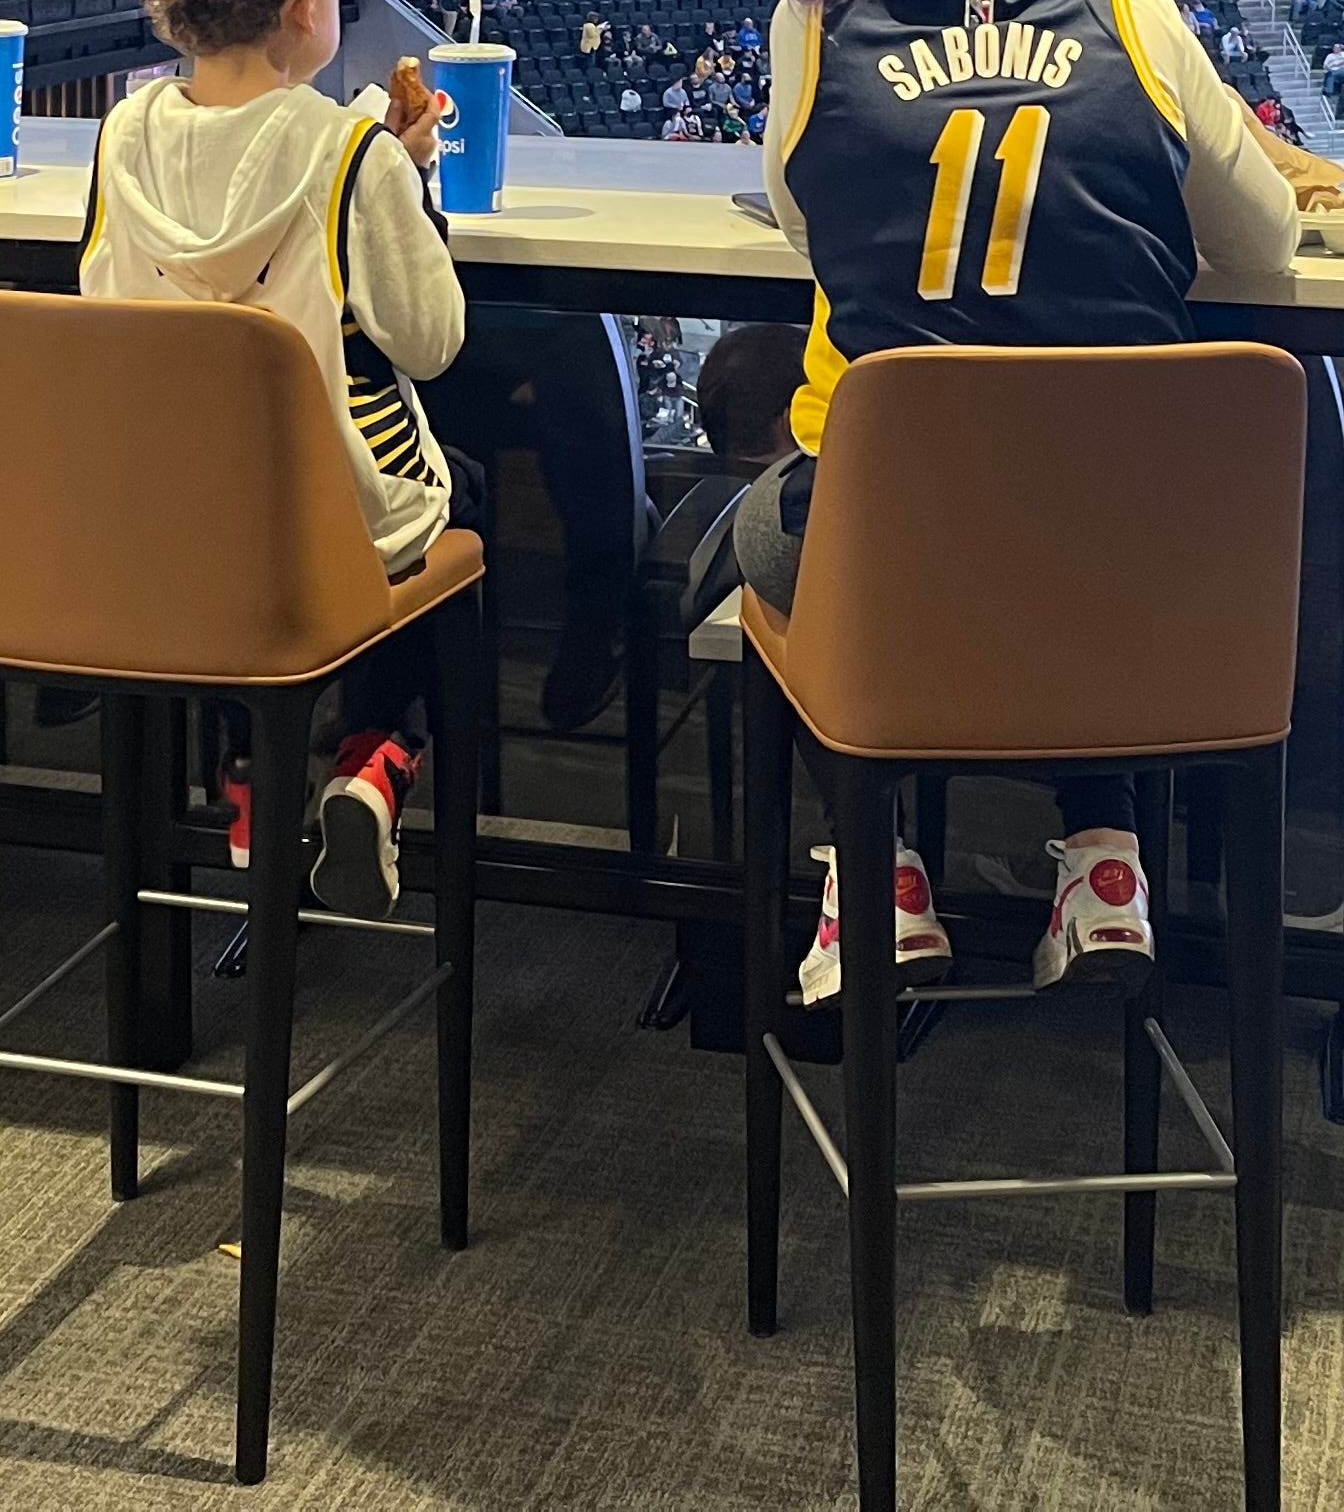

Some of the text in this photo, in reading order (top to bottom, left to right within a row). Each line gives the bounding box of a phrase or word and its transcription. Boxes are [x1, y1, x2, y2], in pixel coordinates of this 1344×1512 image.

[878, 21, 1083, 101] SABONIS
[439, 138, 465, 156] psi
[917, 105, 1051, 301] 11
